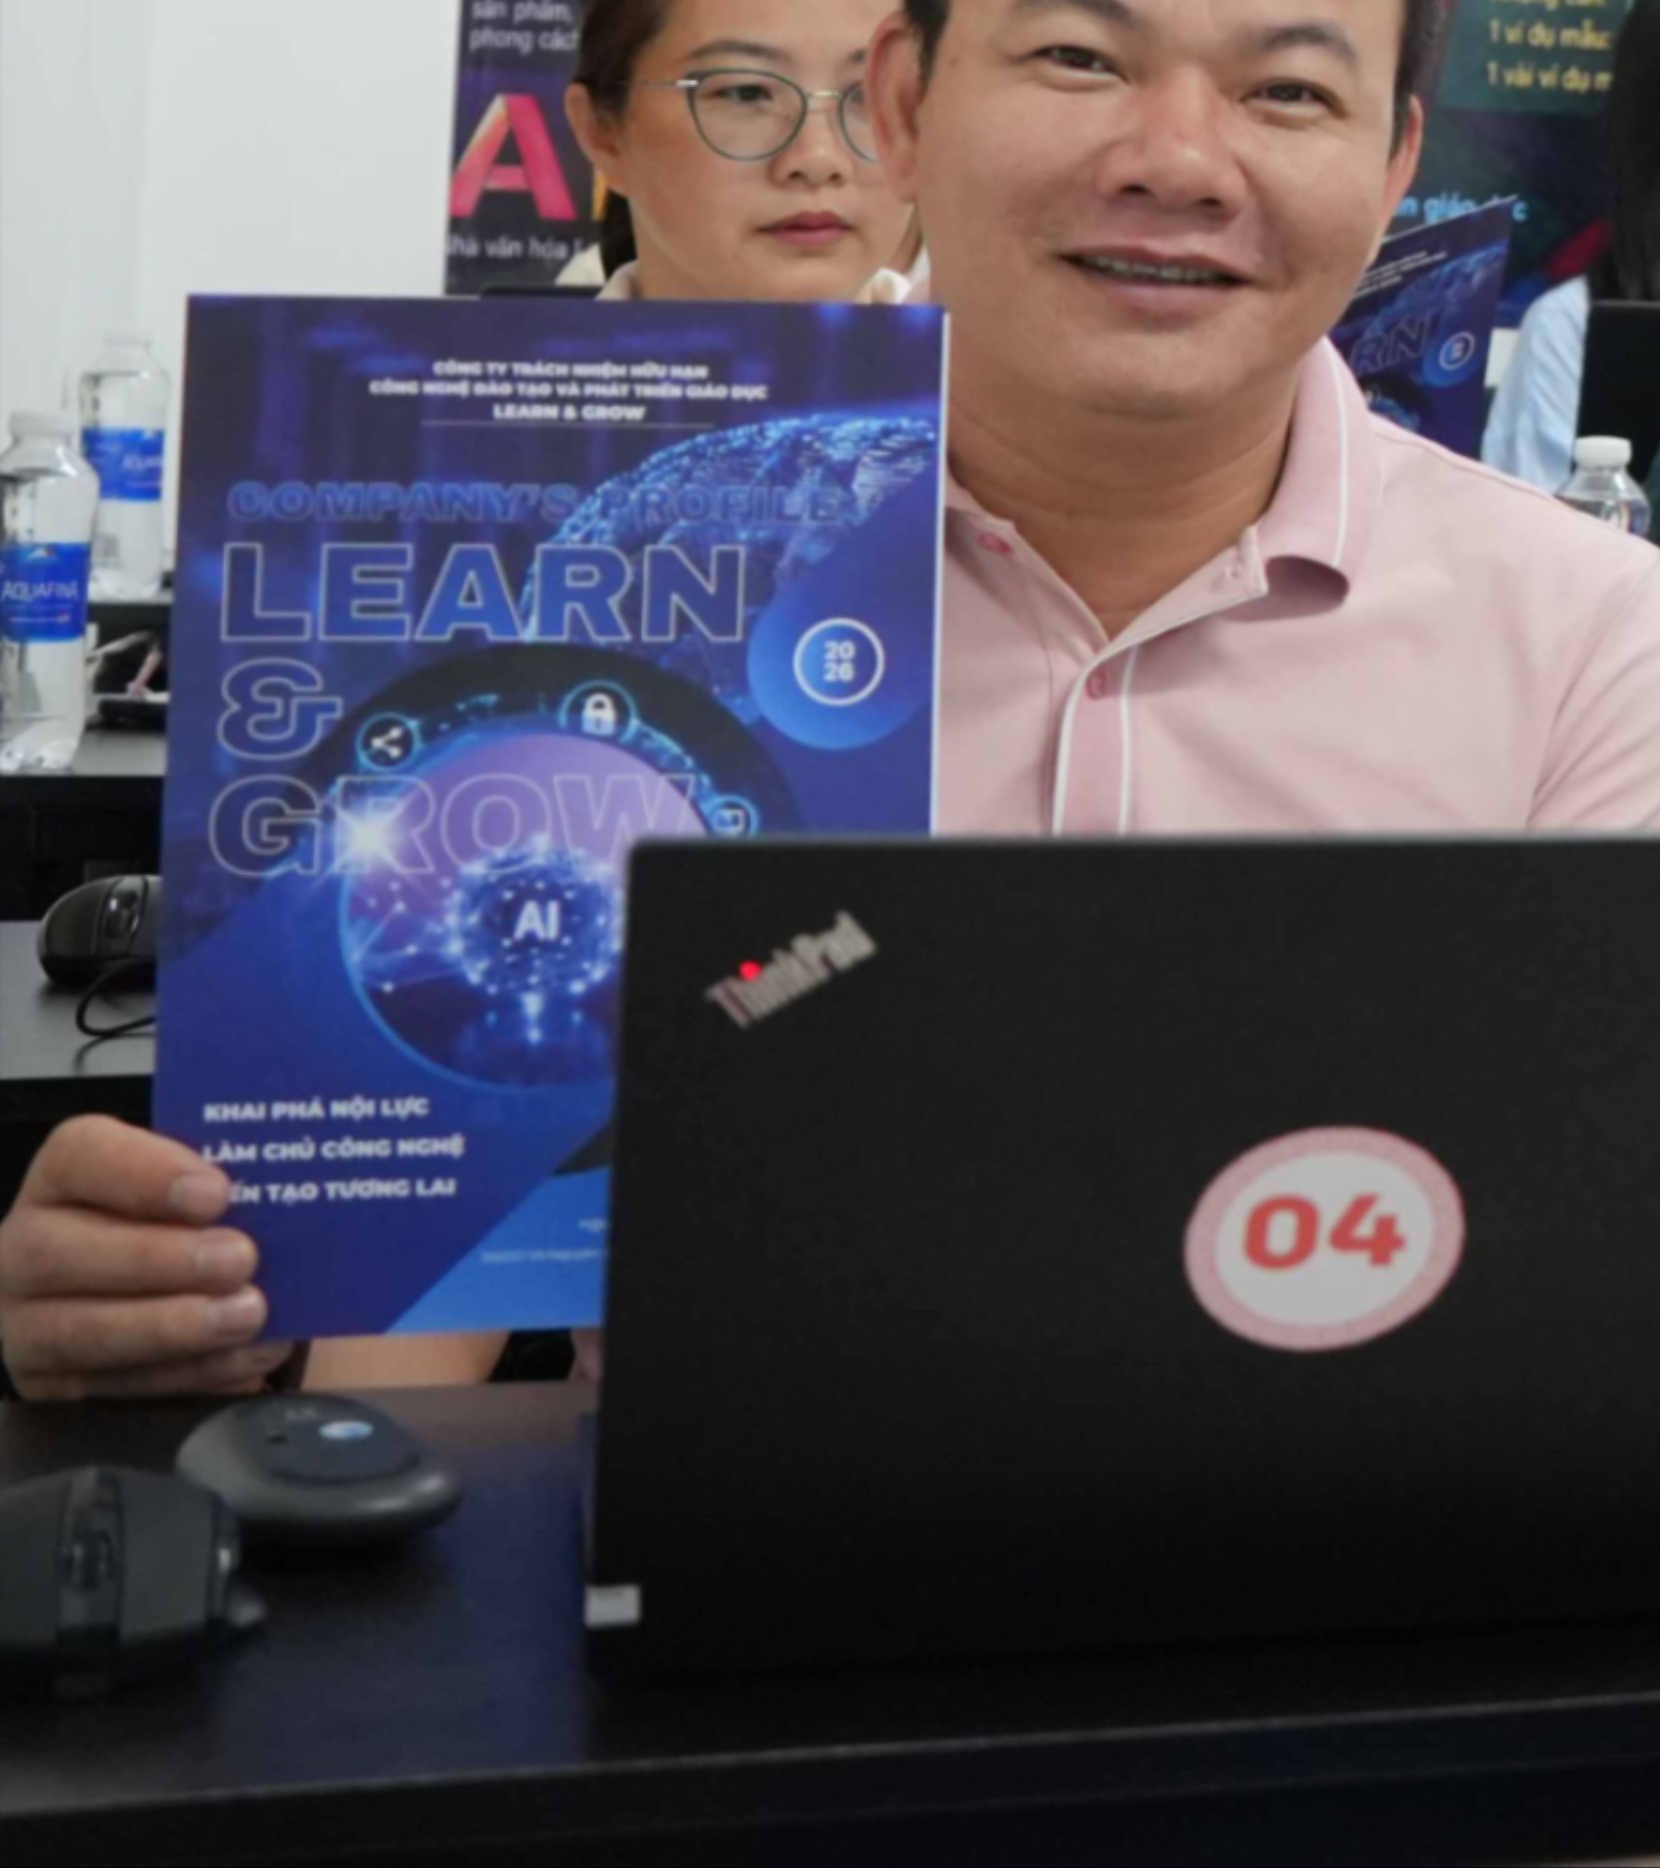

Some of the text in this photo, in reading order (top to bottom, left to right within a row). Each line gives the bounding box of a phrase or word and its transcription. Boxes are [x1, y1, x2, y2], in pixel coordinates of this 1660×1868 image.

[492, 402, 560, 421] LEARN
[581, 403, 648, 422] GROW
[220, 542, 748, 645] LEARN
[822, 639, 857, 661] 20
[217, 657, 344, 762] &
[208, 773, 699, 879] GROW
[514, 899, 562, 941] AI
[203, 1095, 430, 1123] KHAI PHÁ NỘI LỰC
[203, 1132, 466, 1164] LÀM CHỦ CÔNG NGHỆ
[265, 1177, 457, 1205] TẠO TƯƠNG LAI
[1242, 1194, 1407, 1272] 04
